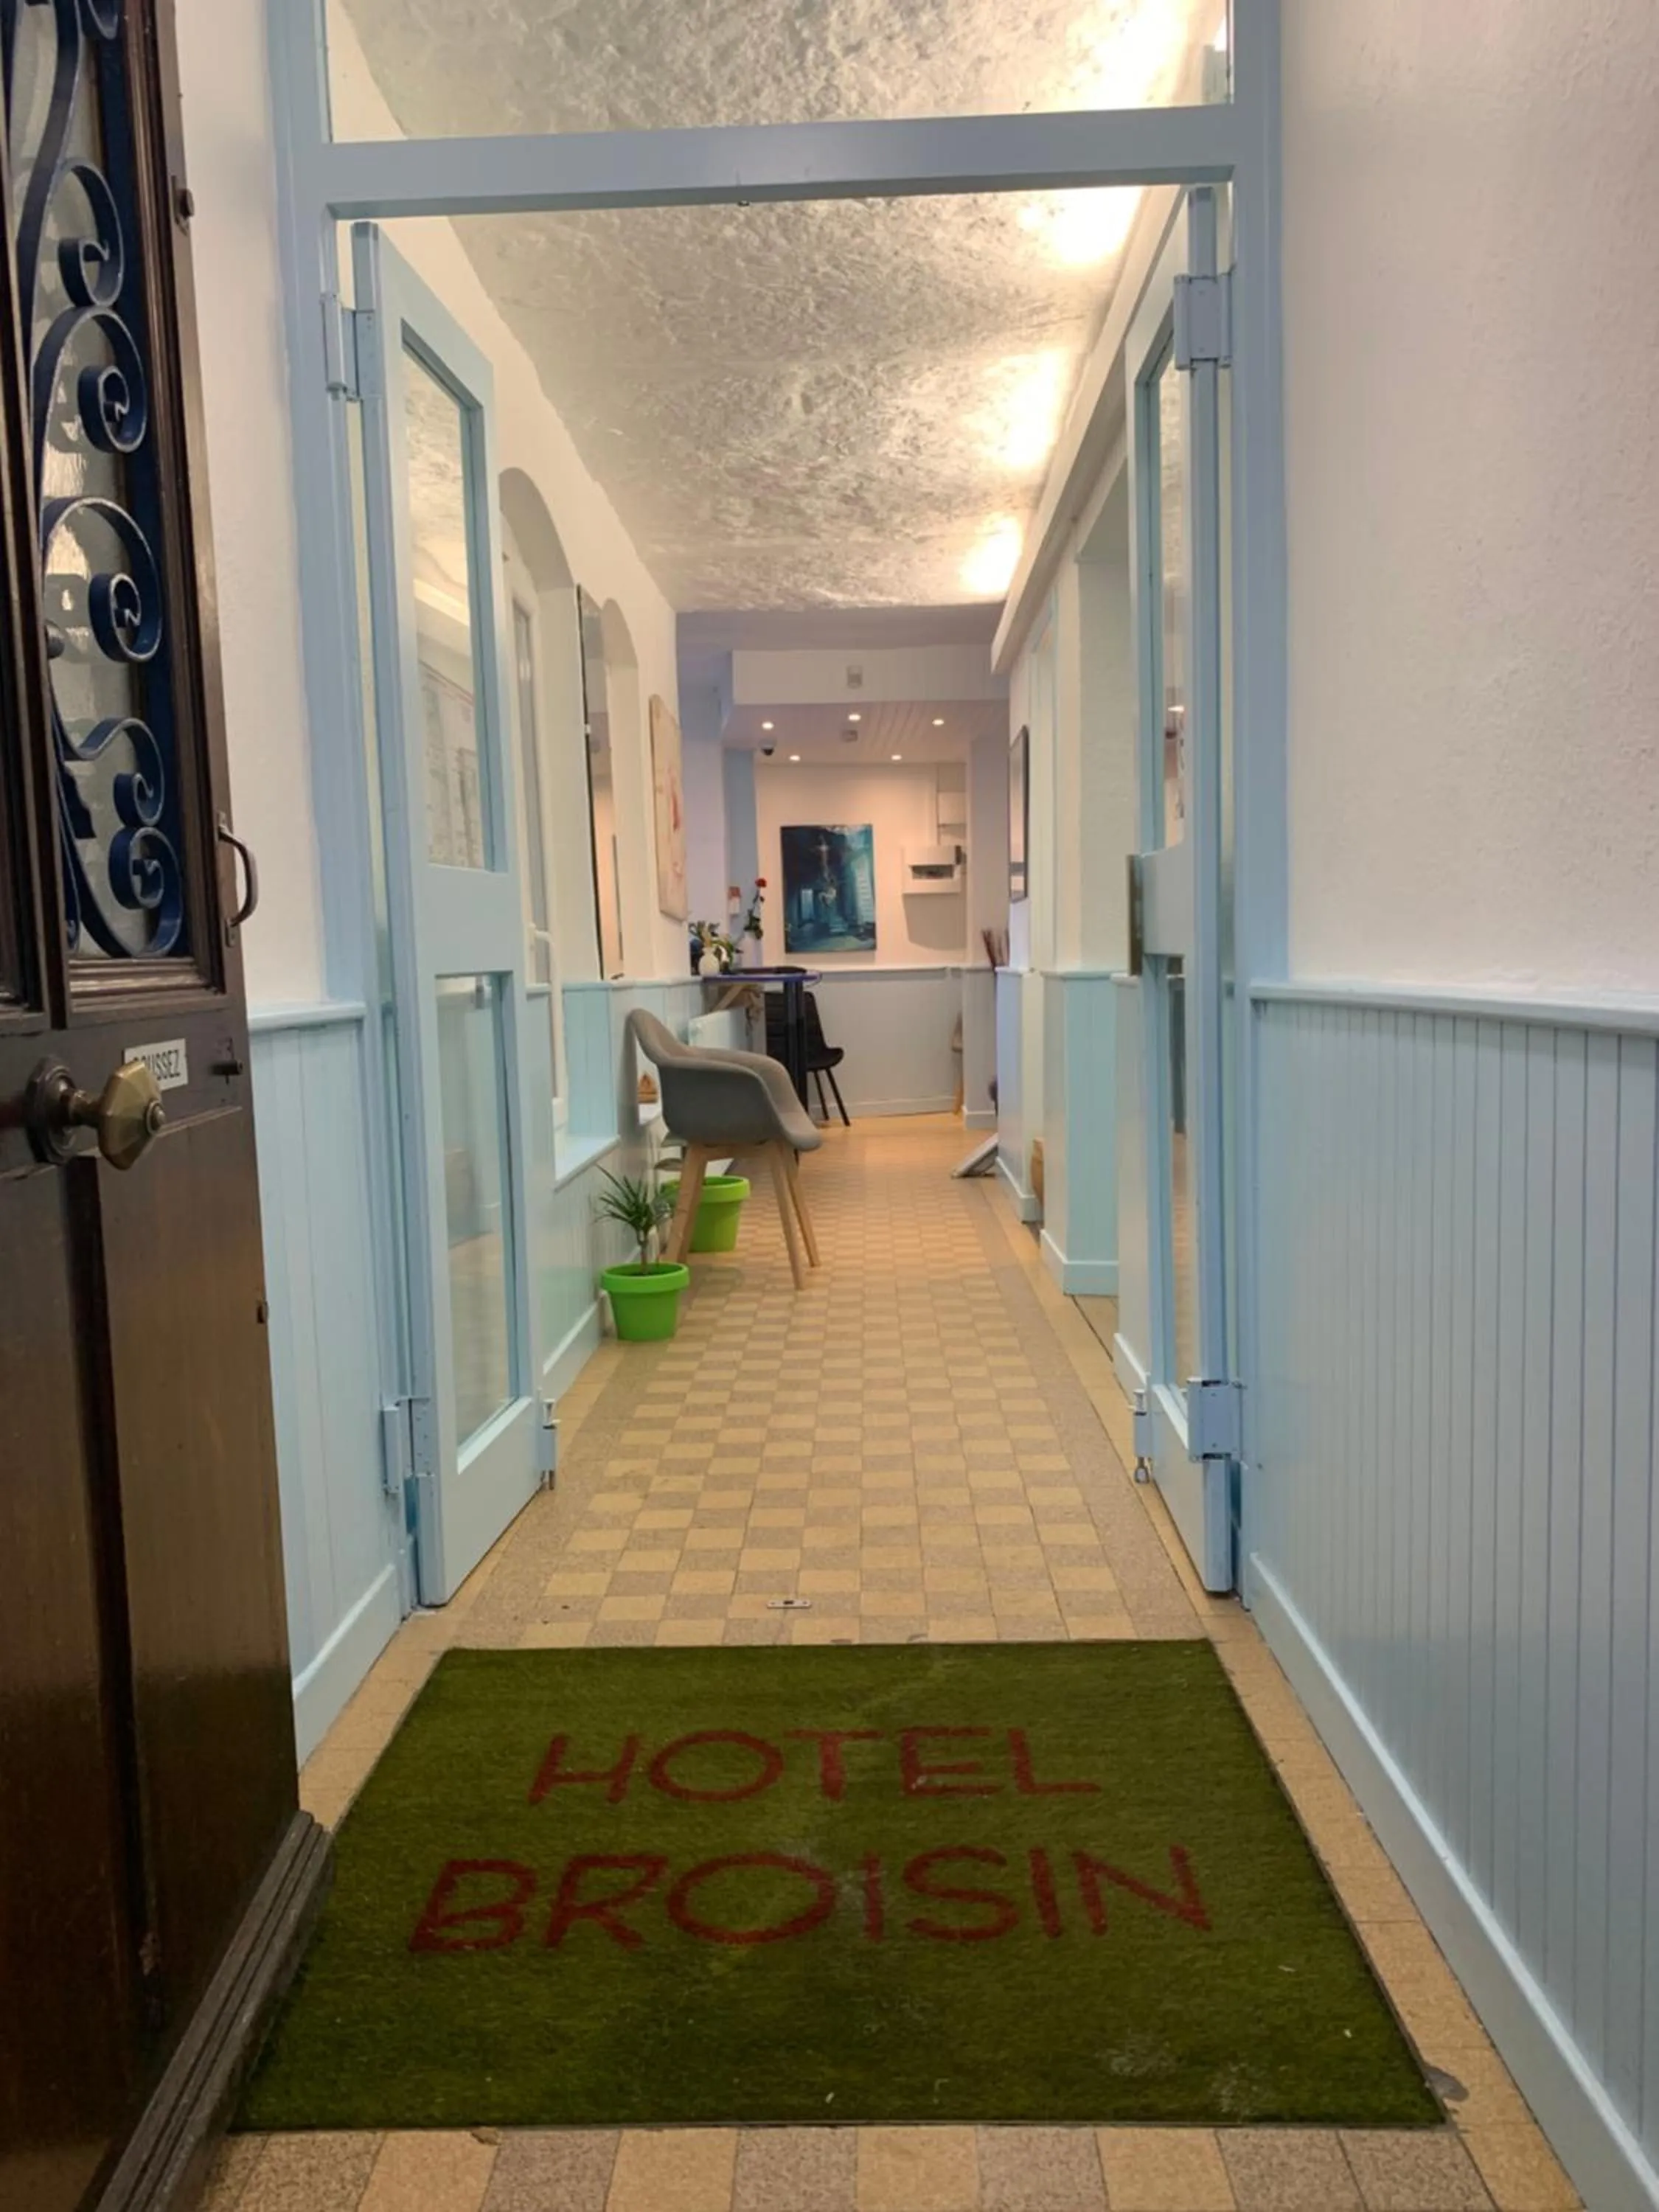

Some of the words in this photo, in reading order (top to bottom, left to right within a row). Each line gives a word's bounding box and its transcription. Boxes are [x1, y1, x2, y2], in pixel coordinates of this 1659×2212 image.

[132, 1050, 180, 1081] USSEZ
[528, 1727, 1102, 1805] HOTEL
[408, 1843, 1213, 1952] BROISIN
